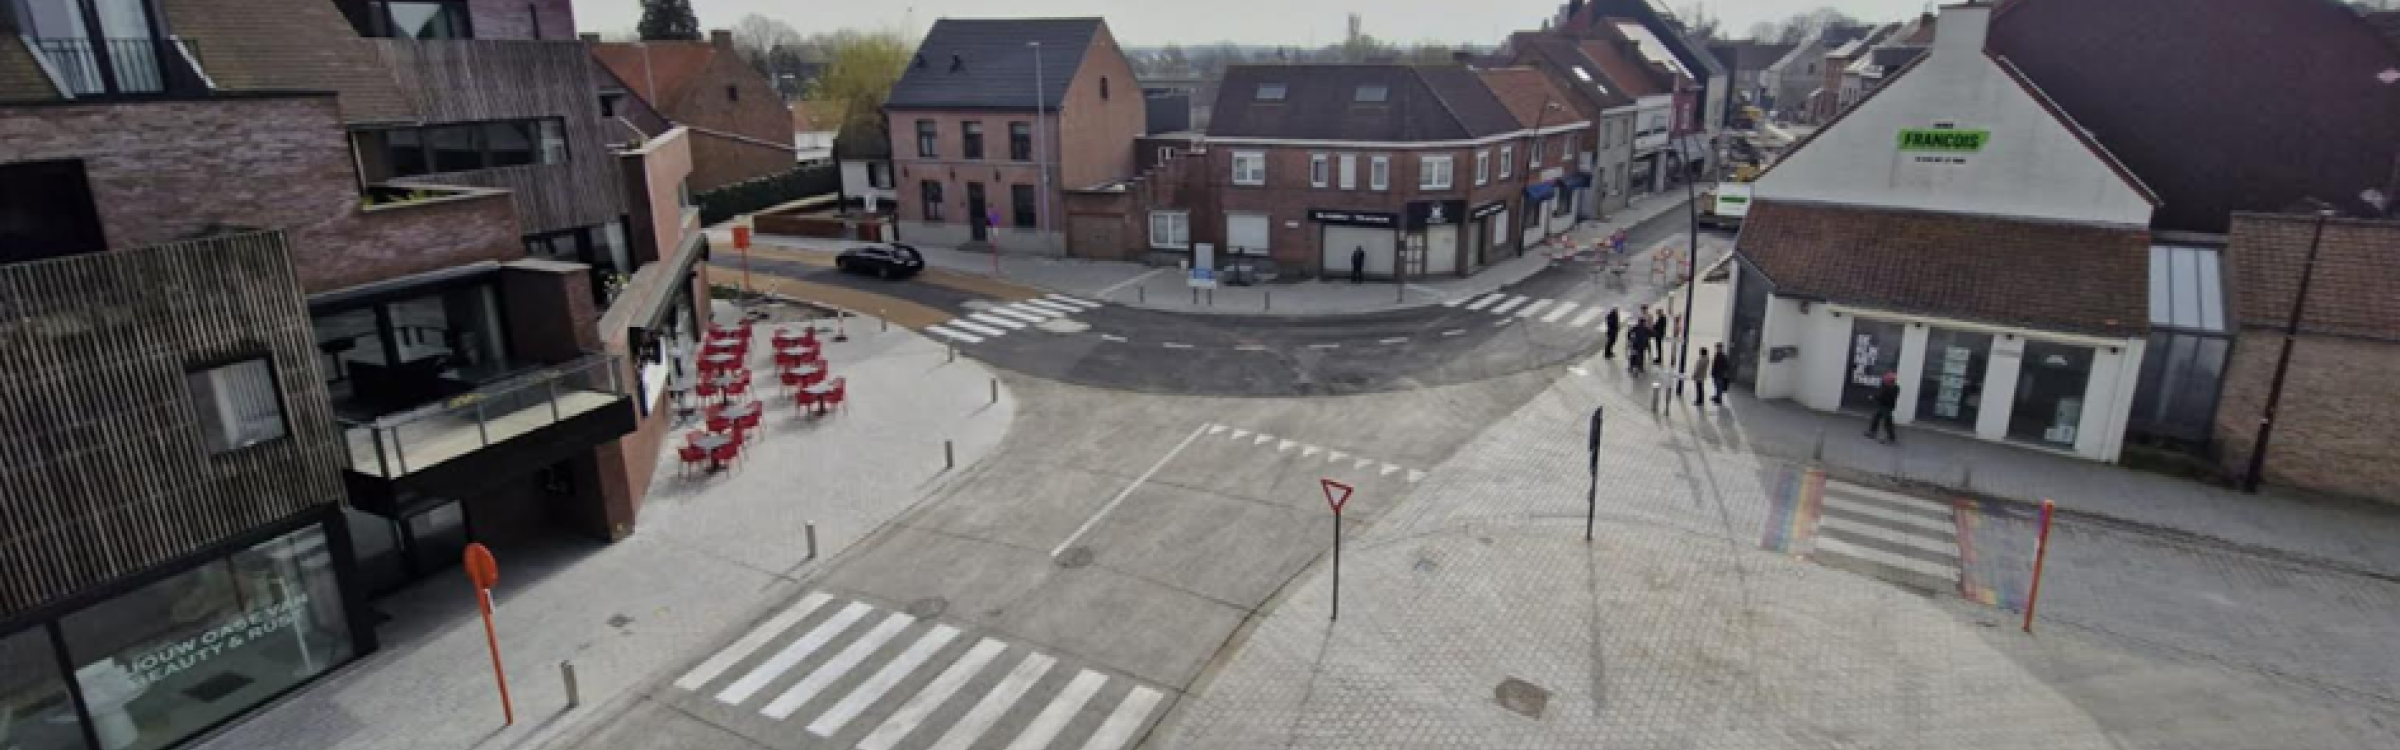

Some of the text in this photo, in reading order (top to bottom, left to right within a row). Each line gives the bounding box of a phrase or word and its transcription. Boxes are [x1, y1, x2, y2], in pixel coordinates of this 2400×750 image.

[129, 641, 224, 687] BEAUTY
[228, 636, 245, 649] &
[131, 638, 196, 673] JOUW
[201, 612, 261, 643] OASE
